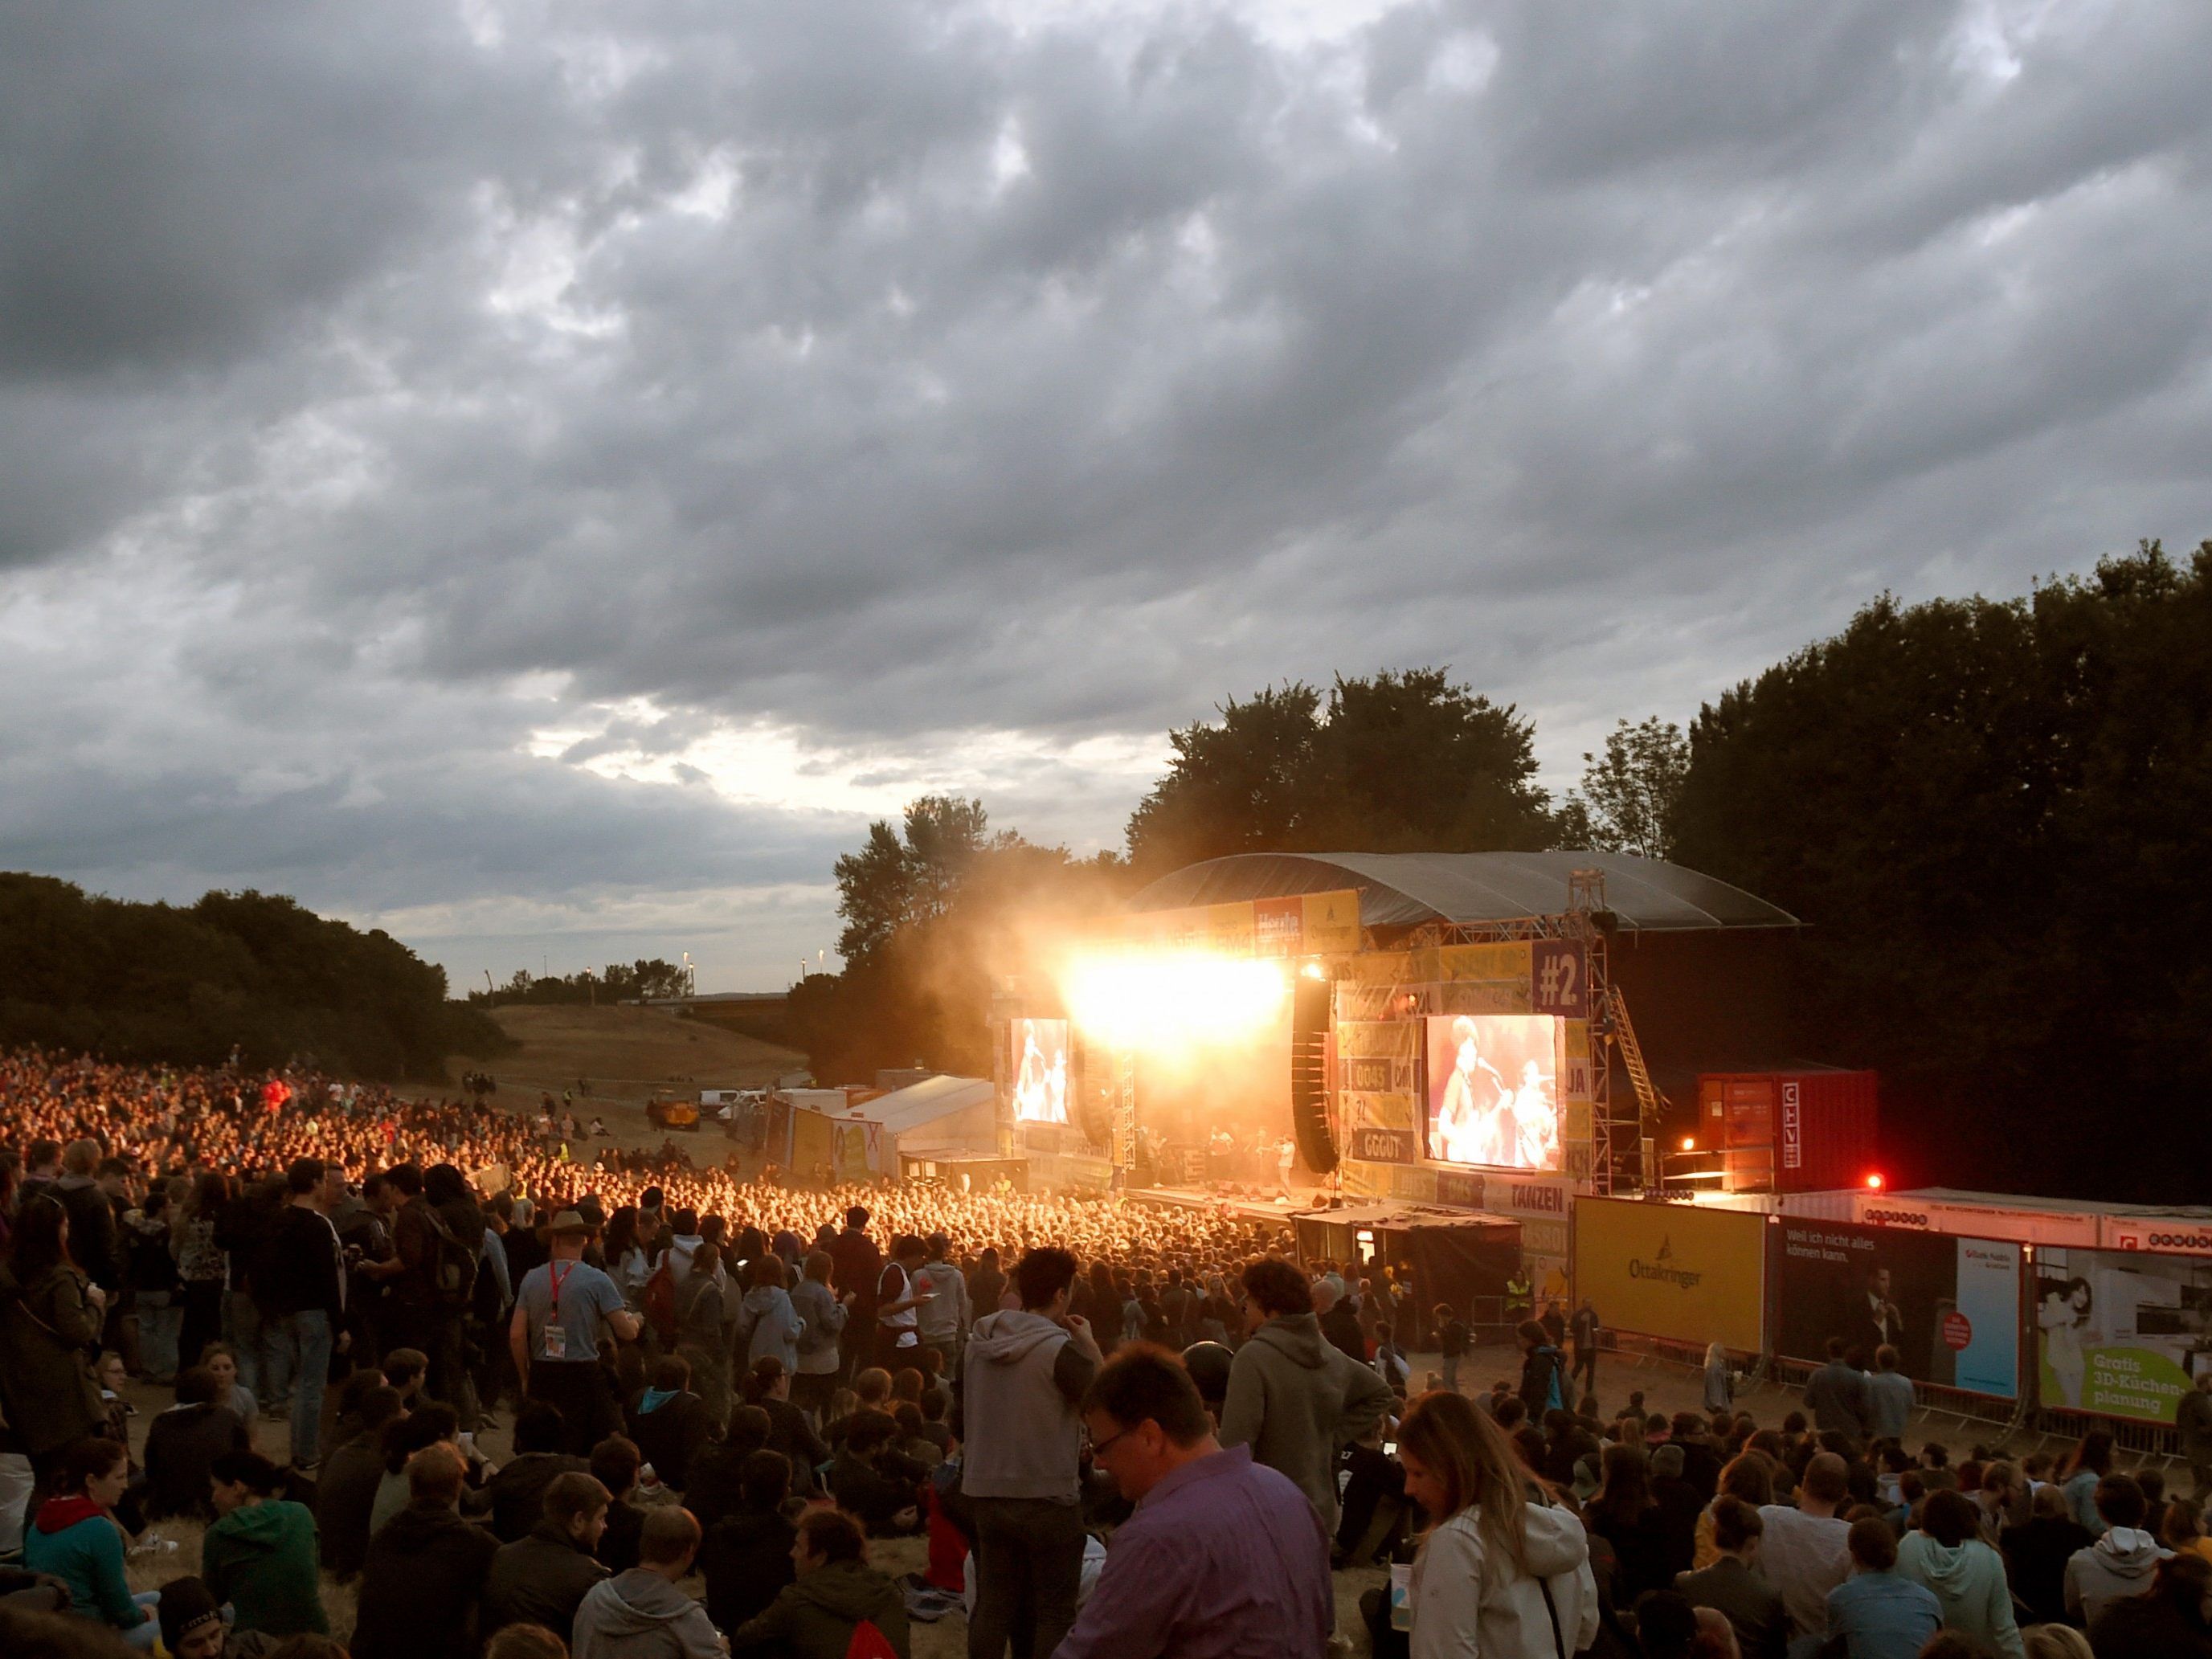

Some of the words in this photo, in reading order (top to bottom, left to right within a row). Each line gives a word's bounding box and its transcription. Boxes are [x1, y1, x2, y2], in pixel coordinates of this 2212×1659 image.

[1568, 1068, 1585, 1093] JA
[1511, 1184, 1564, 1213] TANZEN
[1786, 1228, 1807, 1243] Weil
[1809, 1232, 1823, 1244] ich
[1824, 1234, 1849, 1248] nicht
[1851, 1236, 1875, 1250] alles
[1786, 1243, 1821, 1259] können
[1822, 1248, 1848, 1263] kann.
[1629, 1258, 1702, 1289] Ottakringer
[2093, 1354, 2140, 1373] Gratis
[2093, 1371, 2187, 1396] 3D-Küchen-
[2093, 1390, 2161, 1415] planung
